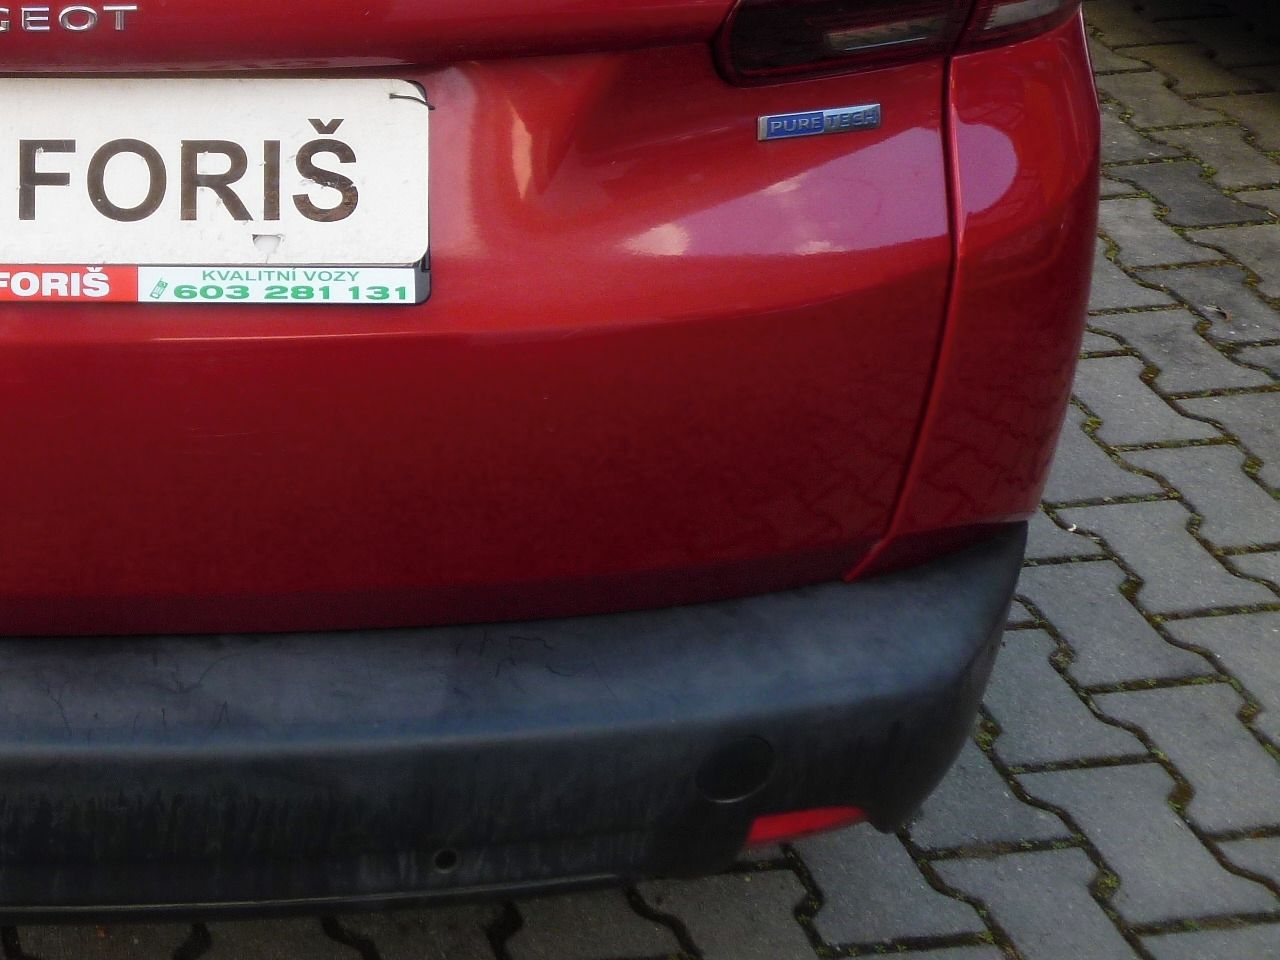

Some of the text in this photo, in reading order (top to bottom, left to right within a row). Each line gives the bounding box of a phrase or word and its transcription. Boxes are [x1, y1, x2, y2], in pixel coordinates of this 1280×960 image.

[19, 119, 358, 223] FORIŠ
[202, 267, 360, 283] KVALITNÍ VOZY
[173, 284, 408, 301] 603 281 131
